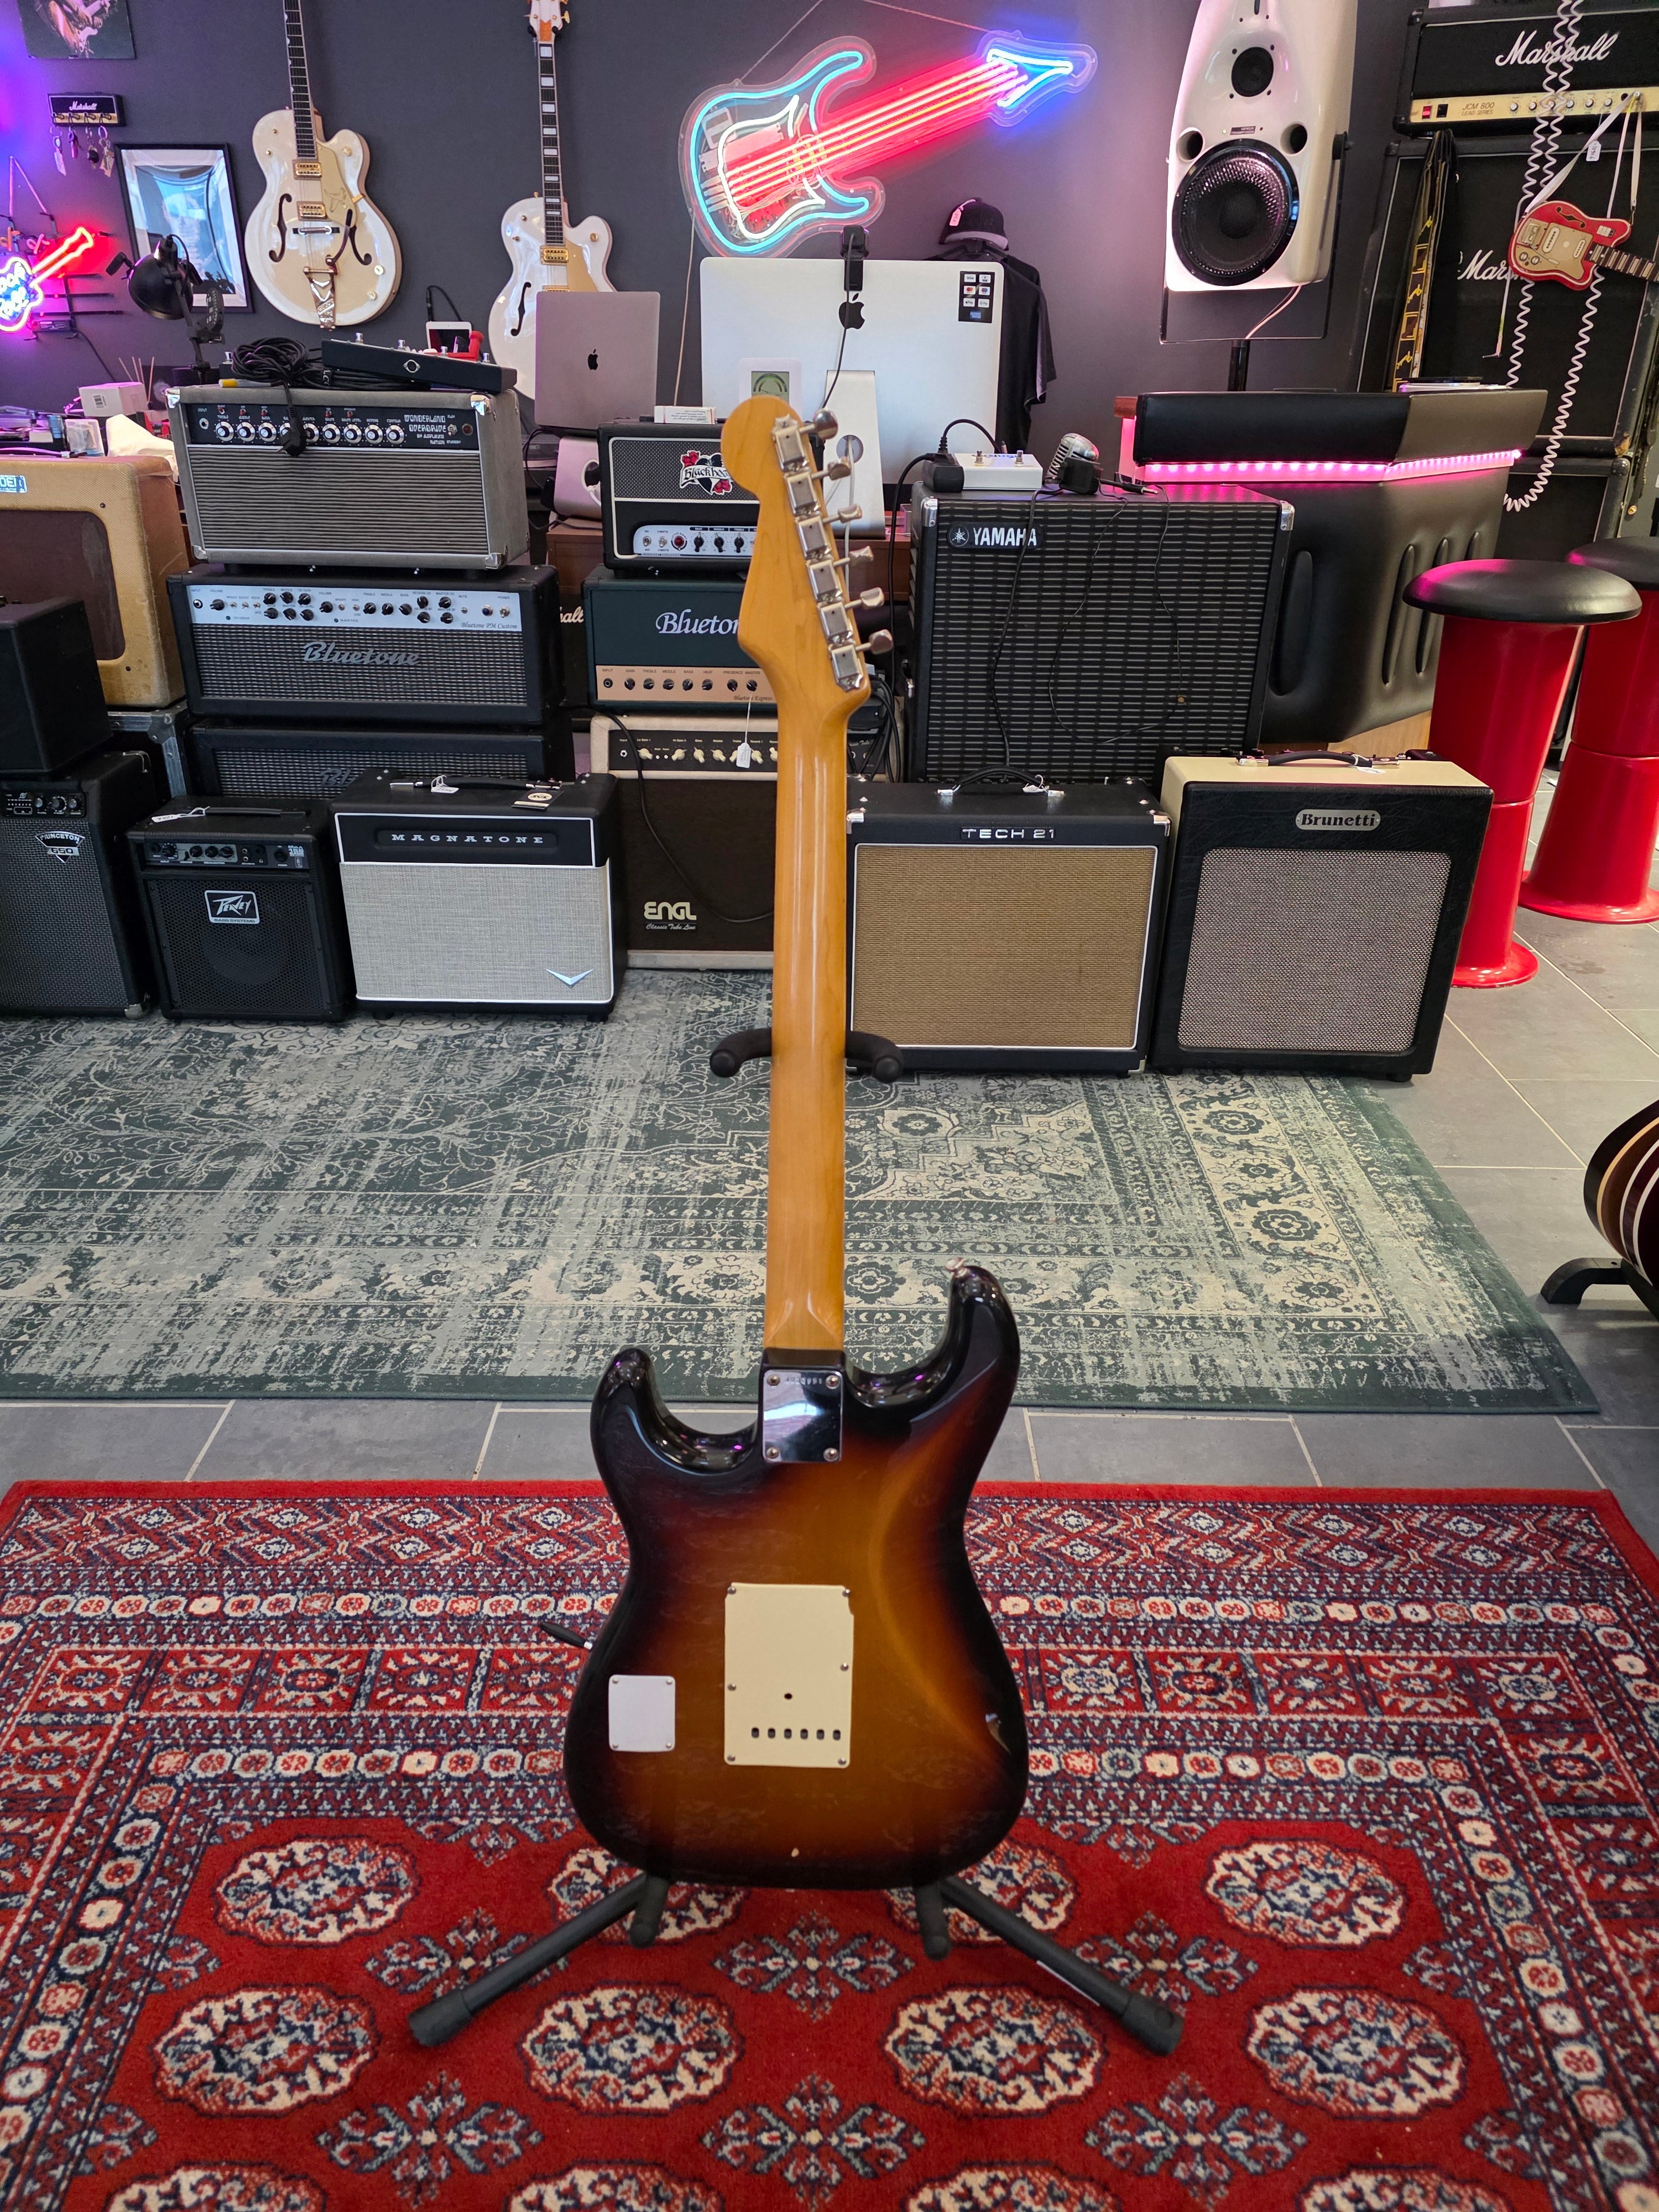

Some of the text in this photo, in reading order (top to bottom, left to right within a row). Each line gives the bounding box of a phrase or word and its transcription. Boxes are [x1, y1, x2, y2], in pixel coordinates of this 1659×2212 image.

[1495, 30, 1620, 66] Marshall
[69, 101, 97, 111] Marshall
[404, 414, 446, 423] WONDERLAND
[409, 424, 447, 432] OVERDRIVE
[973, 527, 1037, 546] YAMAHA
[303, 641, 419, 665] Bluetone
[1301, 813, 1375, 826] Brunetti
[40, 833, 80, 842] PRINCETON
[392, 834, 543, 844] MAGNATONE
[962, 829, 1054, 838] TECH 21
[212, 895, 252, 916] PEAVEY
[644, 901, 697, 920] ENGL
